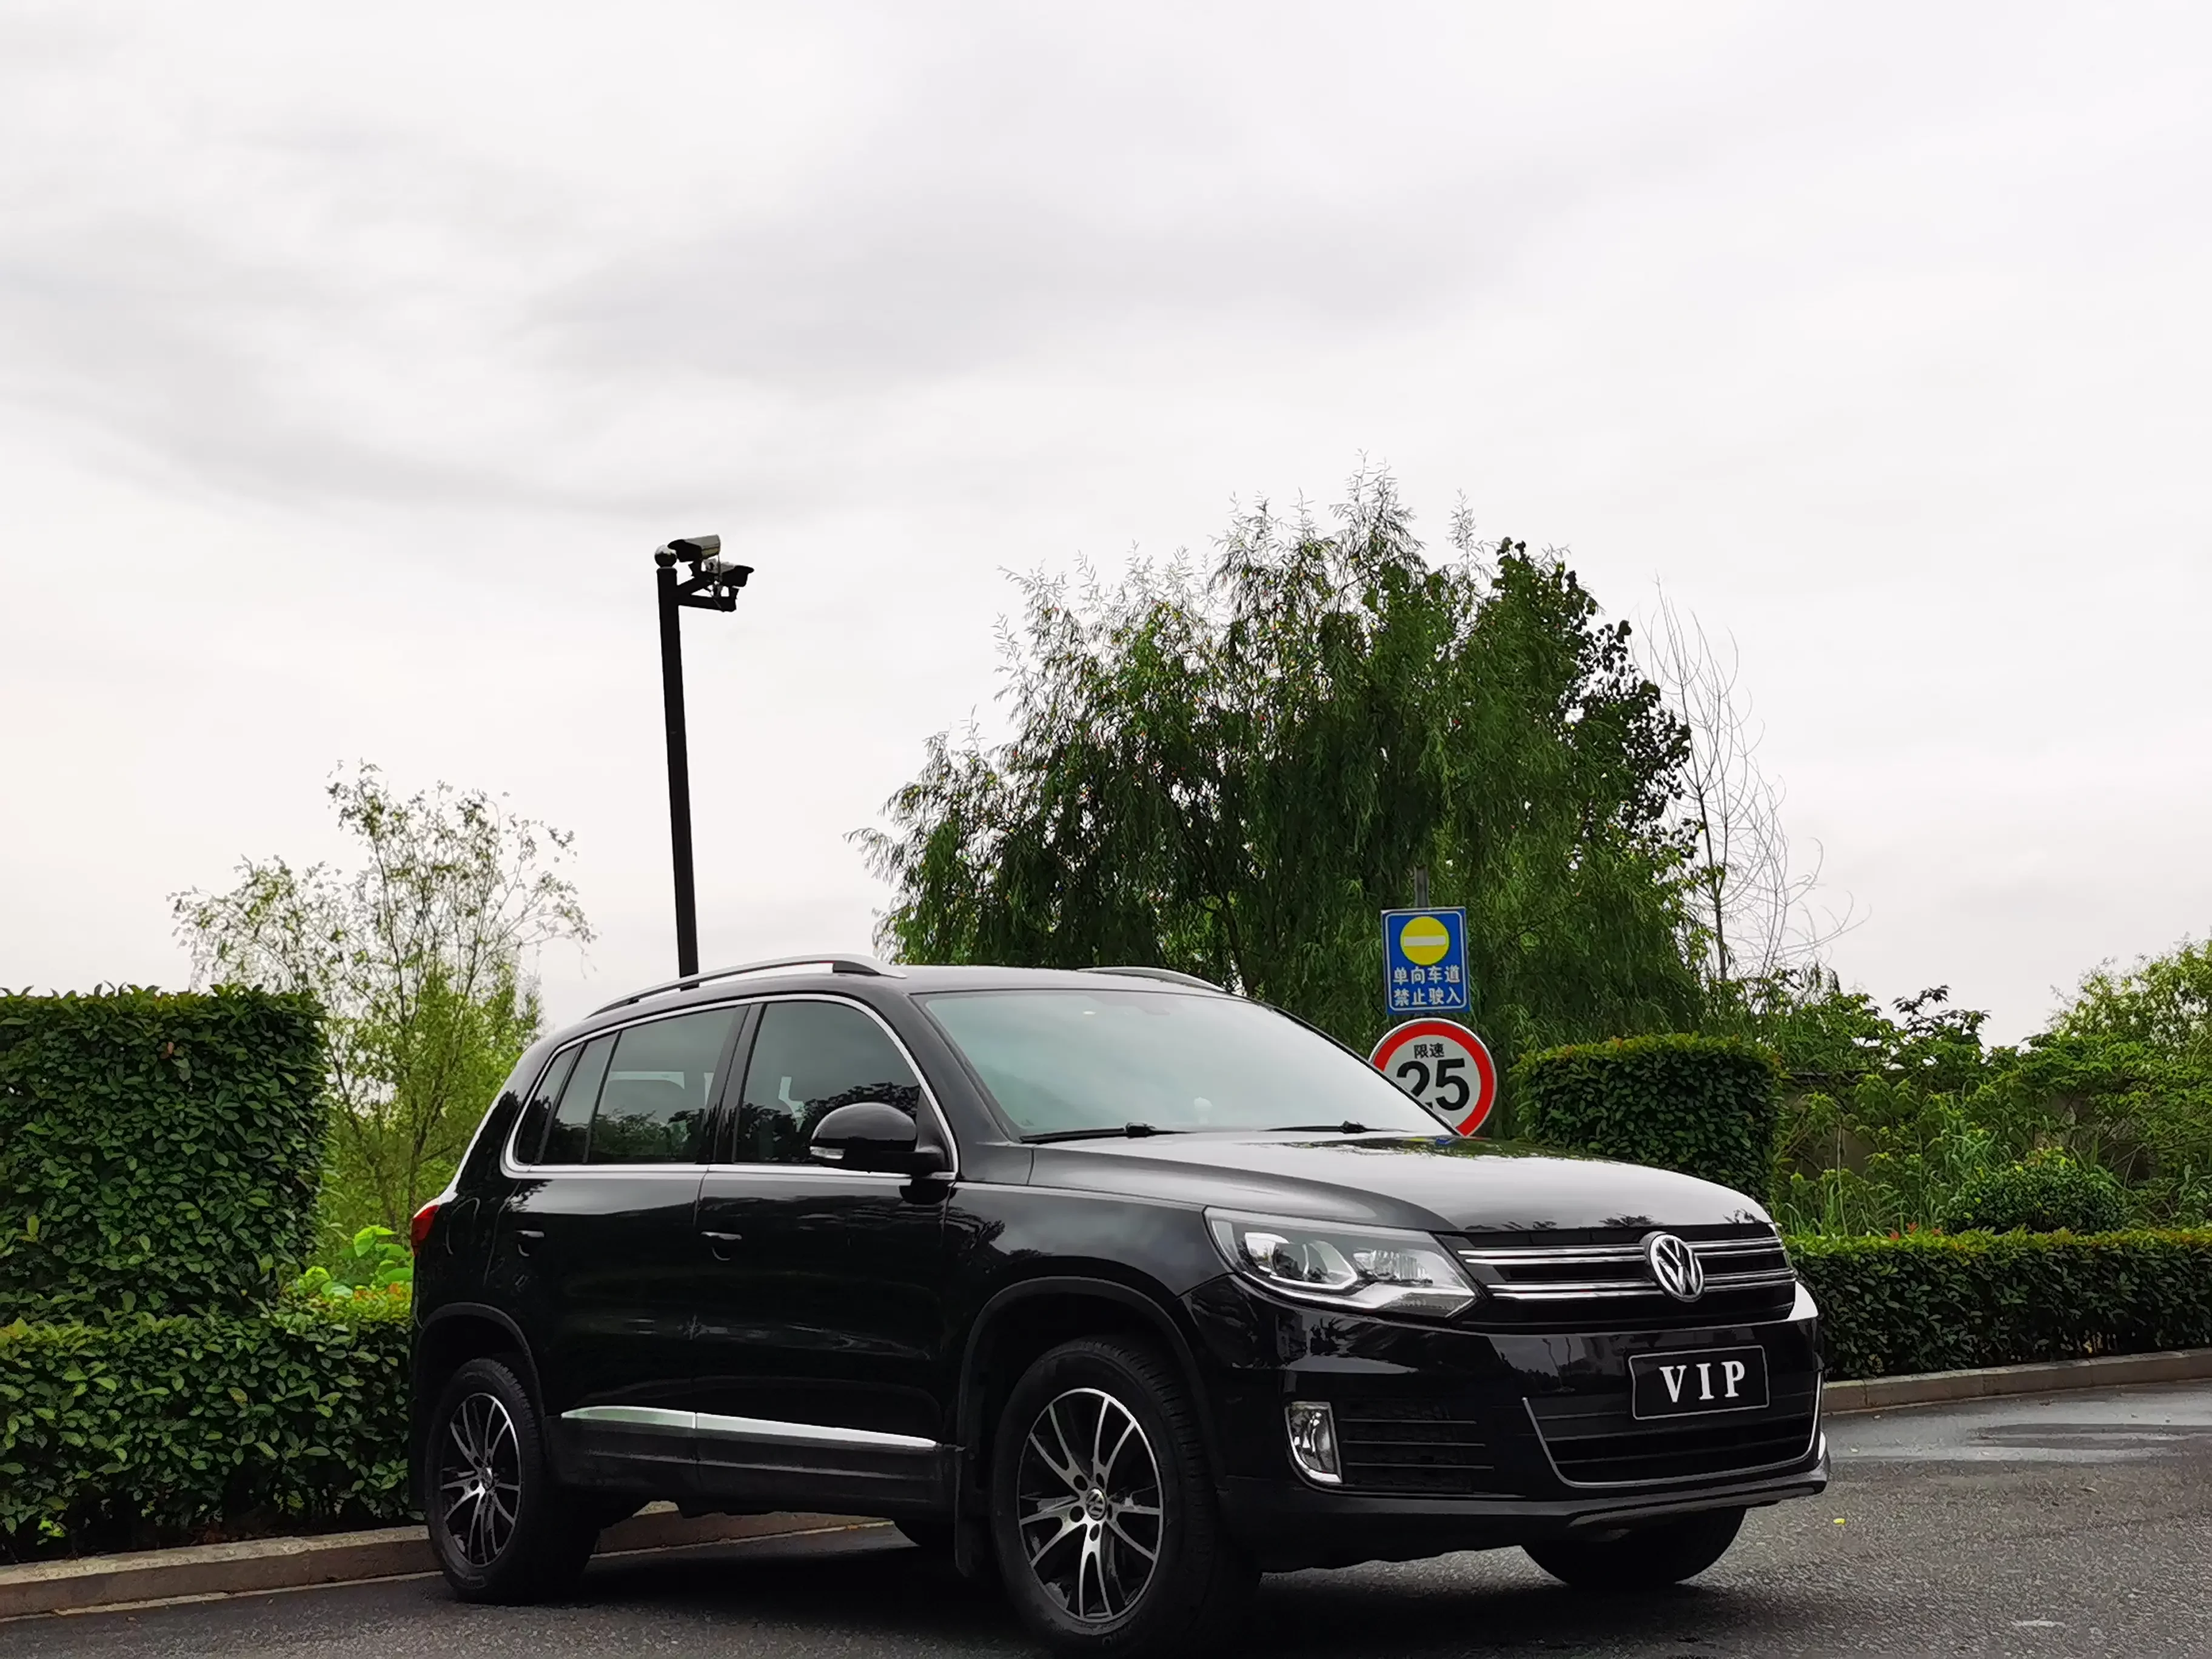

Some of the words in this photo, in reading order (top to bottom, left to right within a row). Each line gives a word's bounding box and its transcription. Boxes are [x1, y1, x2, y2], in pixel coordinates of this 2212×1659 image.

[1394, 965, 1460, 985] 单向车道
[1395, 987, 1461, 1006] 禁止驶入
[1414, 1043, 1444, 1058] 限速
[1396, 1058, 1470, 1111] 25
[1659, 1361, 1744, 1403] VIP
